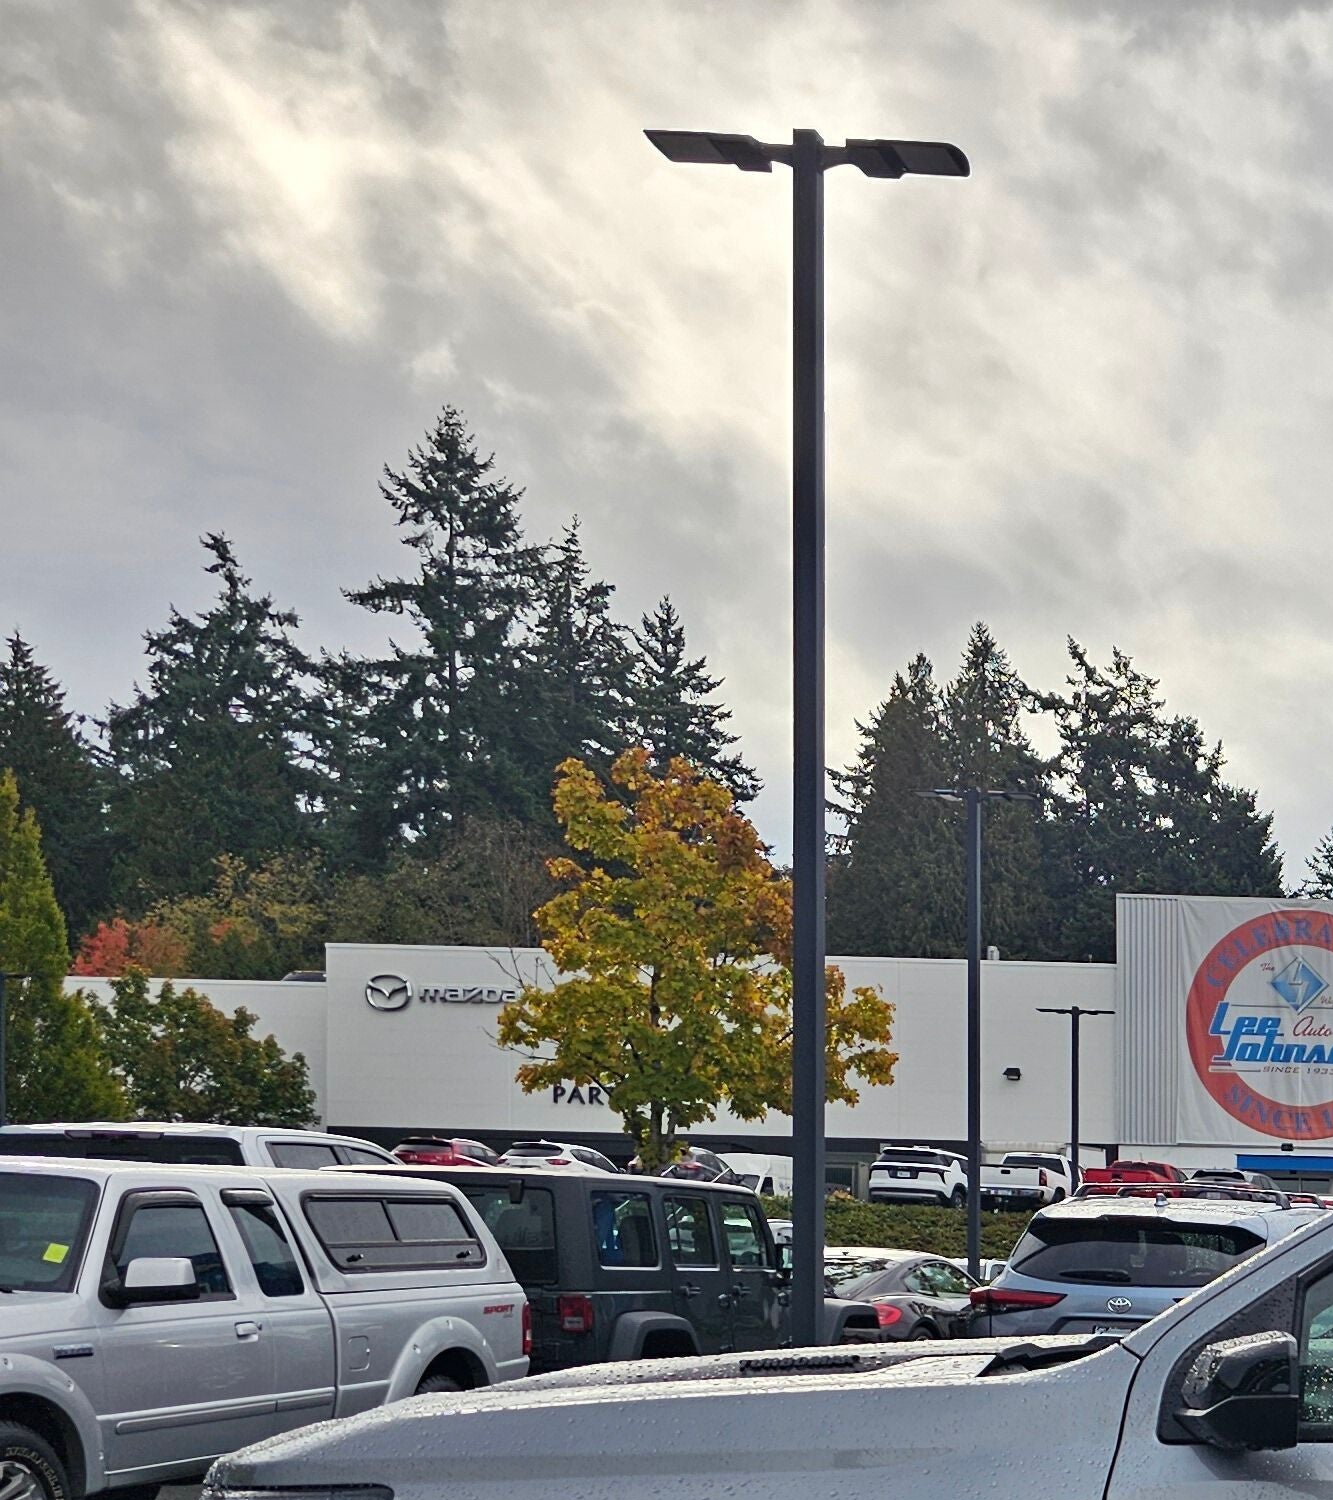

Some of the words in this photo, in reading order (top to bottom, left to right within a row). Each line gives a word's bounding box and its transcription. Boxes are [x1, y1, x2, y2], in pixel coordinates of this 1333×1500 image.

[1209, 1001, 1284, 1036] Lee
[1293, 1015, 1332, 1038] Auto
[1263, 1066, 1300, 1074] SINCE
[1225, 1084, 1313, 1133] SINCE
[483, 1304, 515, 1314] SPORT
